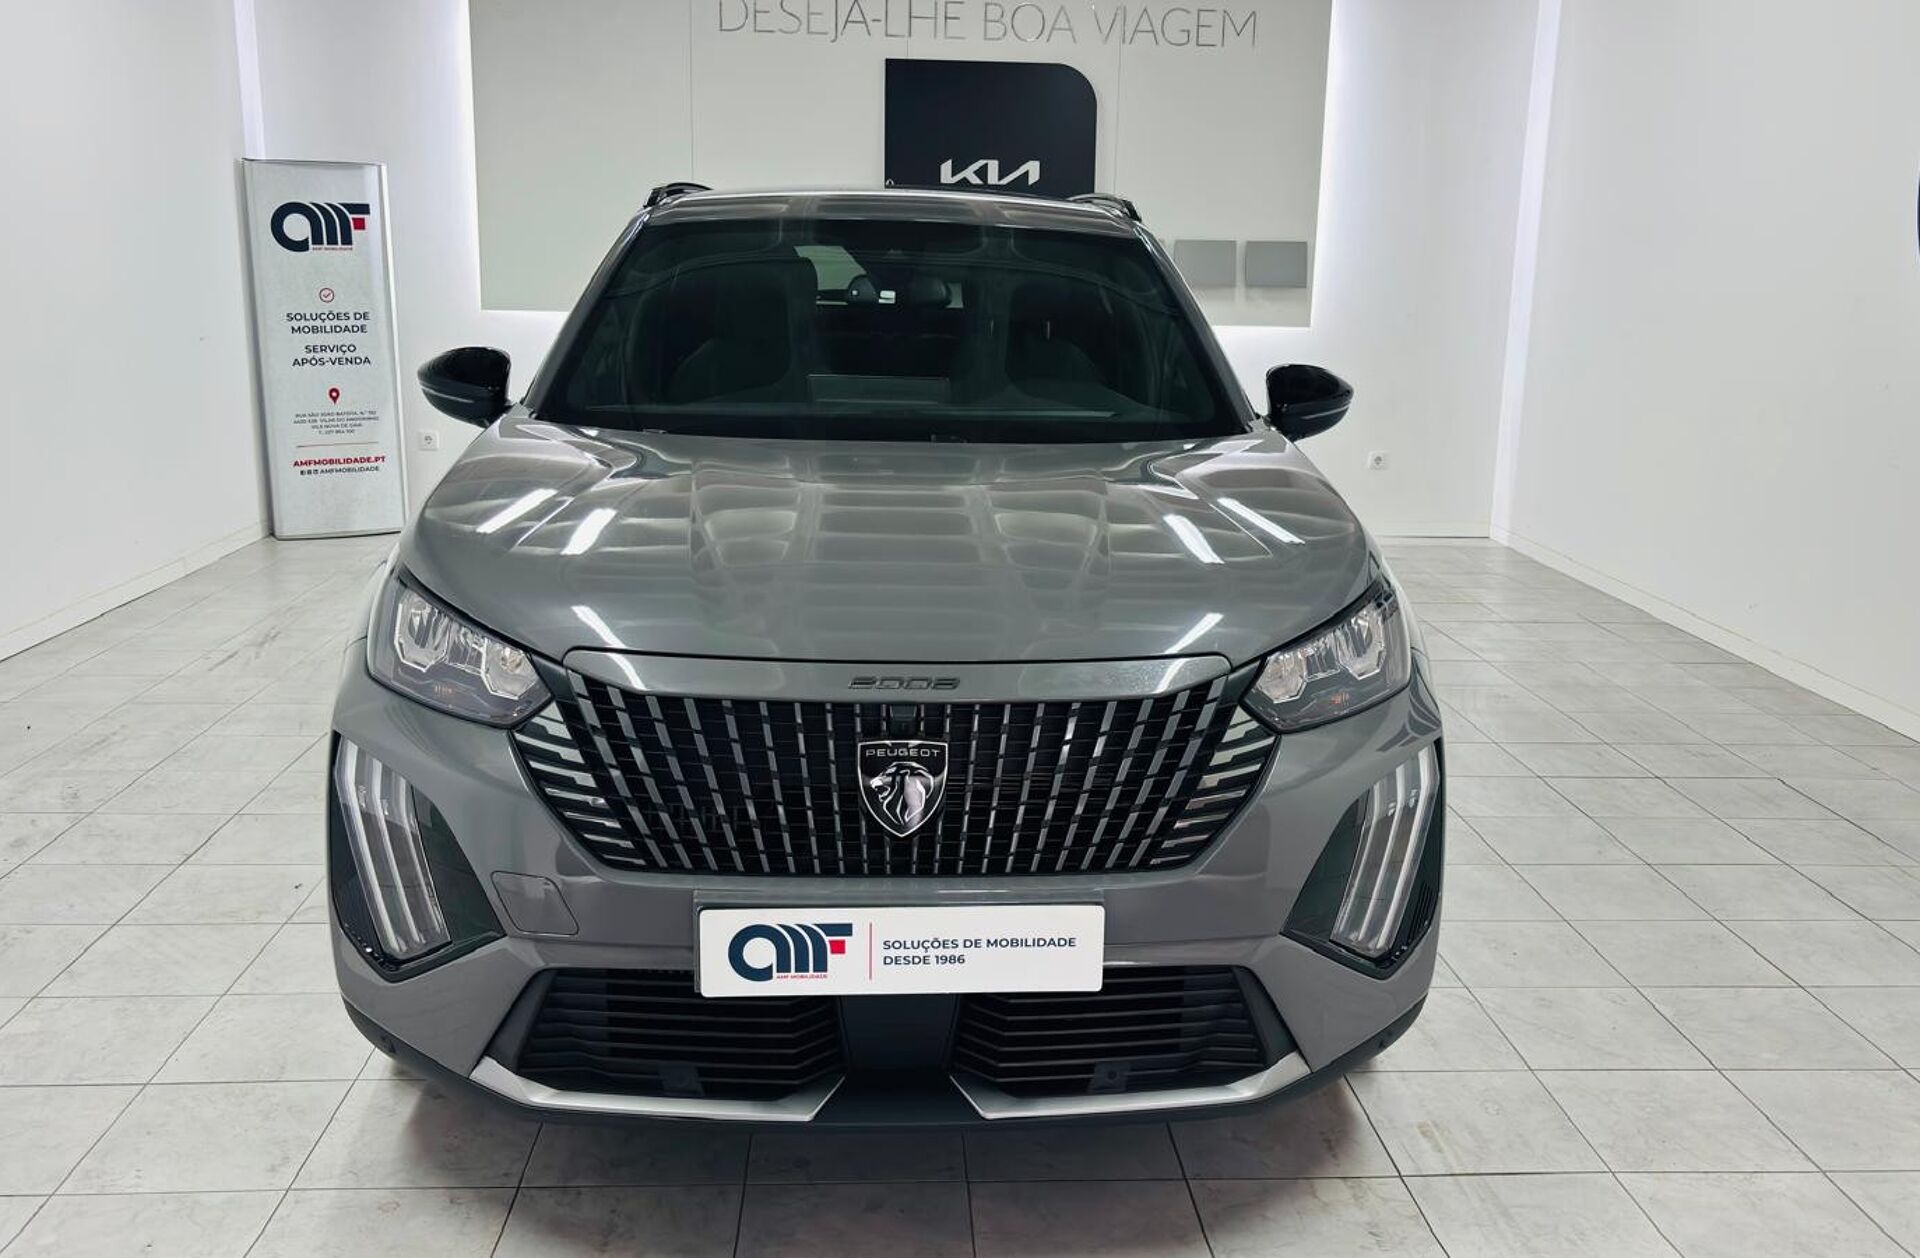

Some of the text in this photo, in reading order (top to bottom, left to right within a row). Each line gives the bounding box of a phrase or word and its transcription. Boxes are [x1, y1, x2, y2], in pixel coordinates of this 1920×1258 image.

[719, 0, 1257, 48] DESEJA-LHE BOA VIAGEM
[940, 159, 1040, 185] KIA
[286, 310, 370, 323] SOLUÇÕES DE
[291, 324, 368, 334] MOBILIDADE
[304, 343, 357, 355] SERVIÇO
[292, 355, 371, 367] APÓS-VENDA
[293, 455, 386, 467] AMFMOBILIDADE.PT
[848, 676, 960, 690] 2008
[866, 749, 941, 757] PEUGEOT
[883, 937, 1077, 953] SOLUÇÕES DE MOBILIDADE
[883, 954, 965, 965] DESDE 1986
